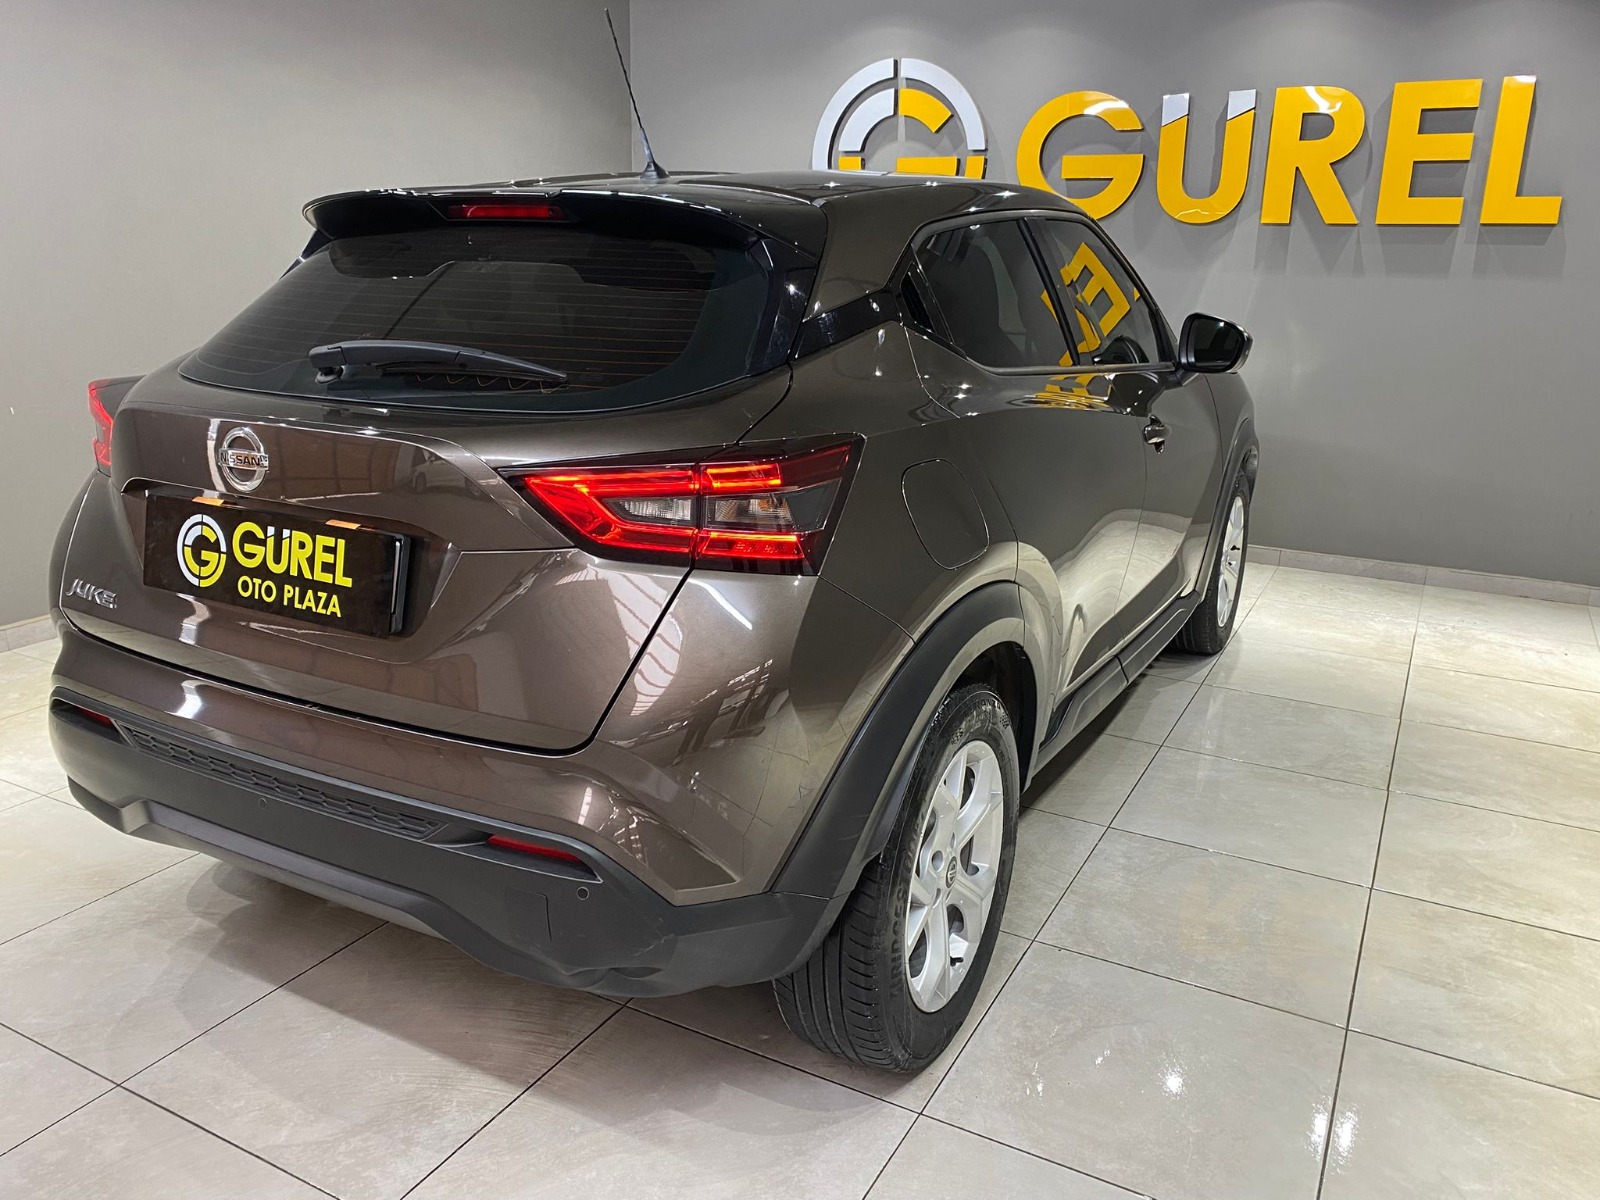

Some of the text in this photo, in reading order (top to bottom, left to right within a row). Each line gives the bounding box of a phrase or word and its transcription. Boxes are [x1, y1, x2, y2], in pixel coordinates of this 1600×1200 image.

[65, 578, 117, 609] JUKE
[237, 575, 342, 618] OTO PLAZA
